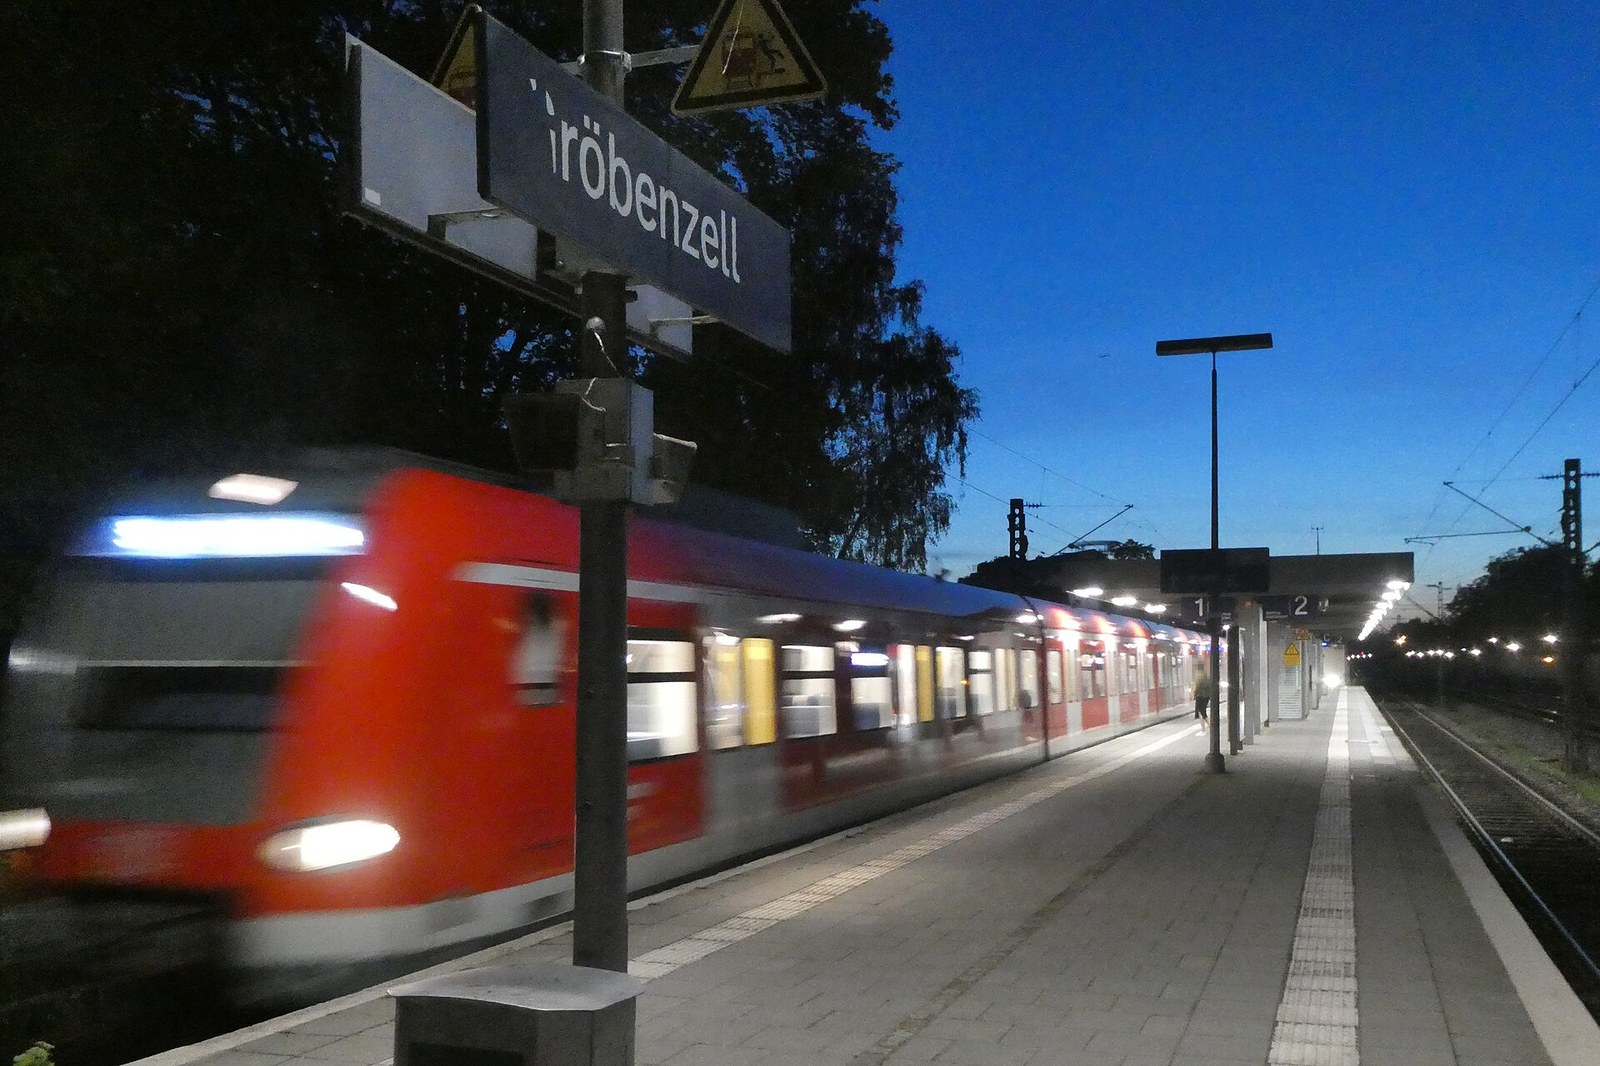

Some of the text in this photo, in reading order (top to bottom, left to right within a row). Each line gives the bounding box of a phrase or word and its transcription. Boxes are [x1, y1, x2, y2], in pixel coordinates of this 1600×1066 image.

[529, 78, 741, 284] röbenzell
[1194, 597, 1204, 617] 1
[1294, 595, 1308, 616] 2
